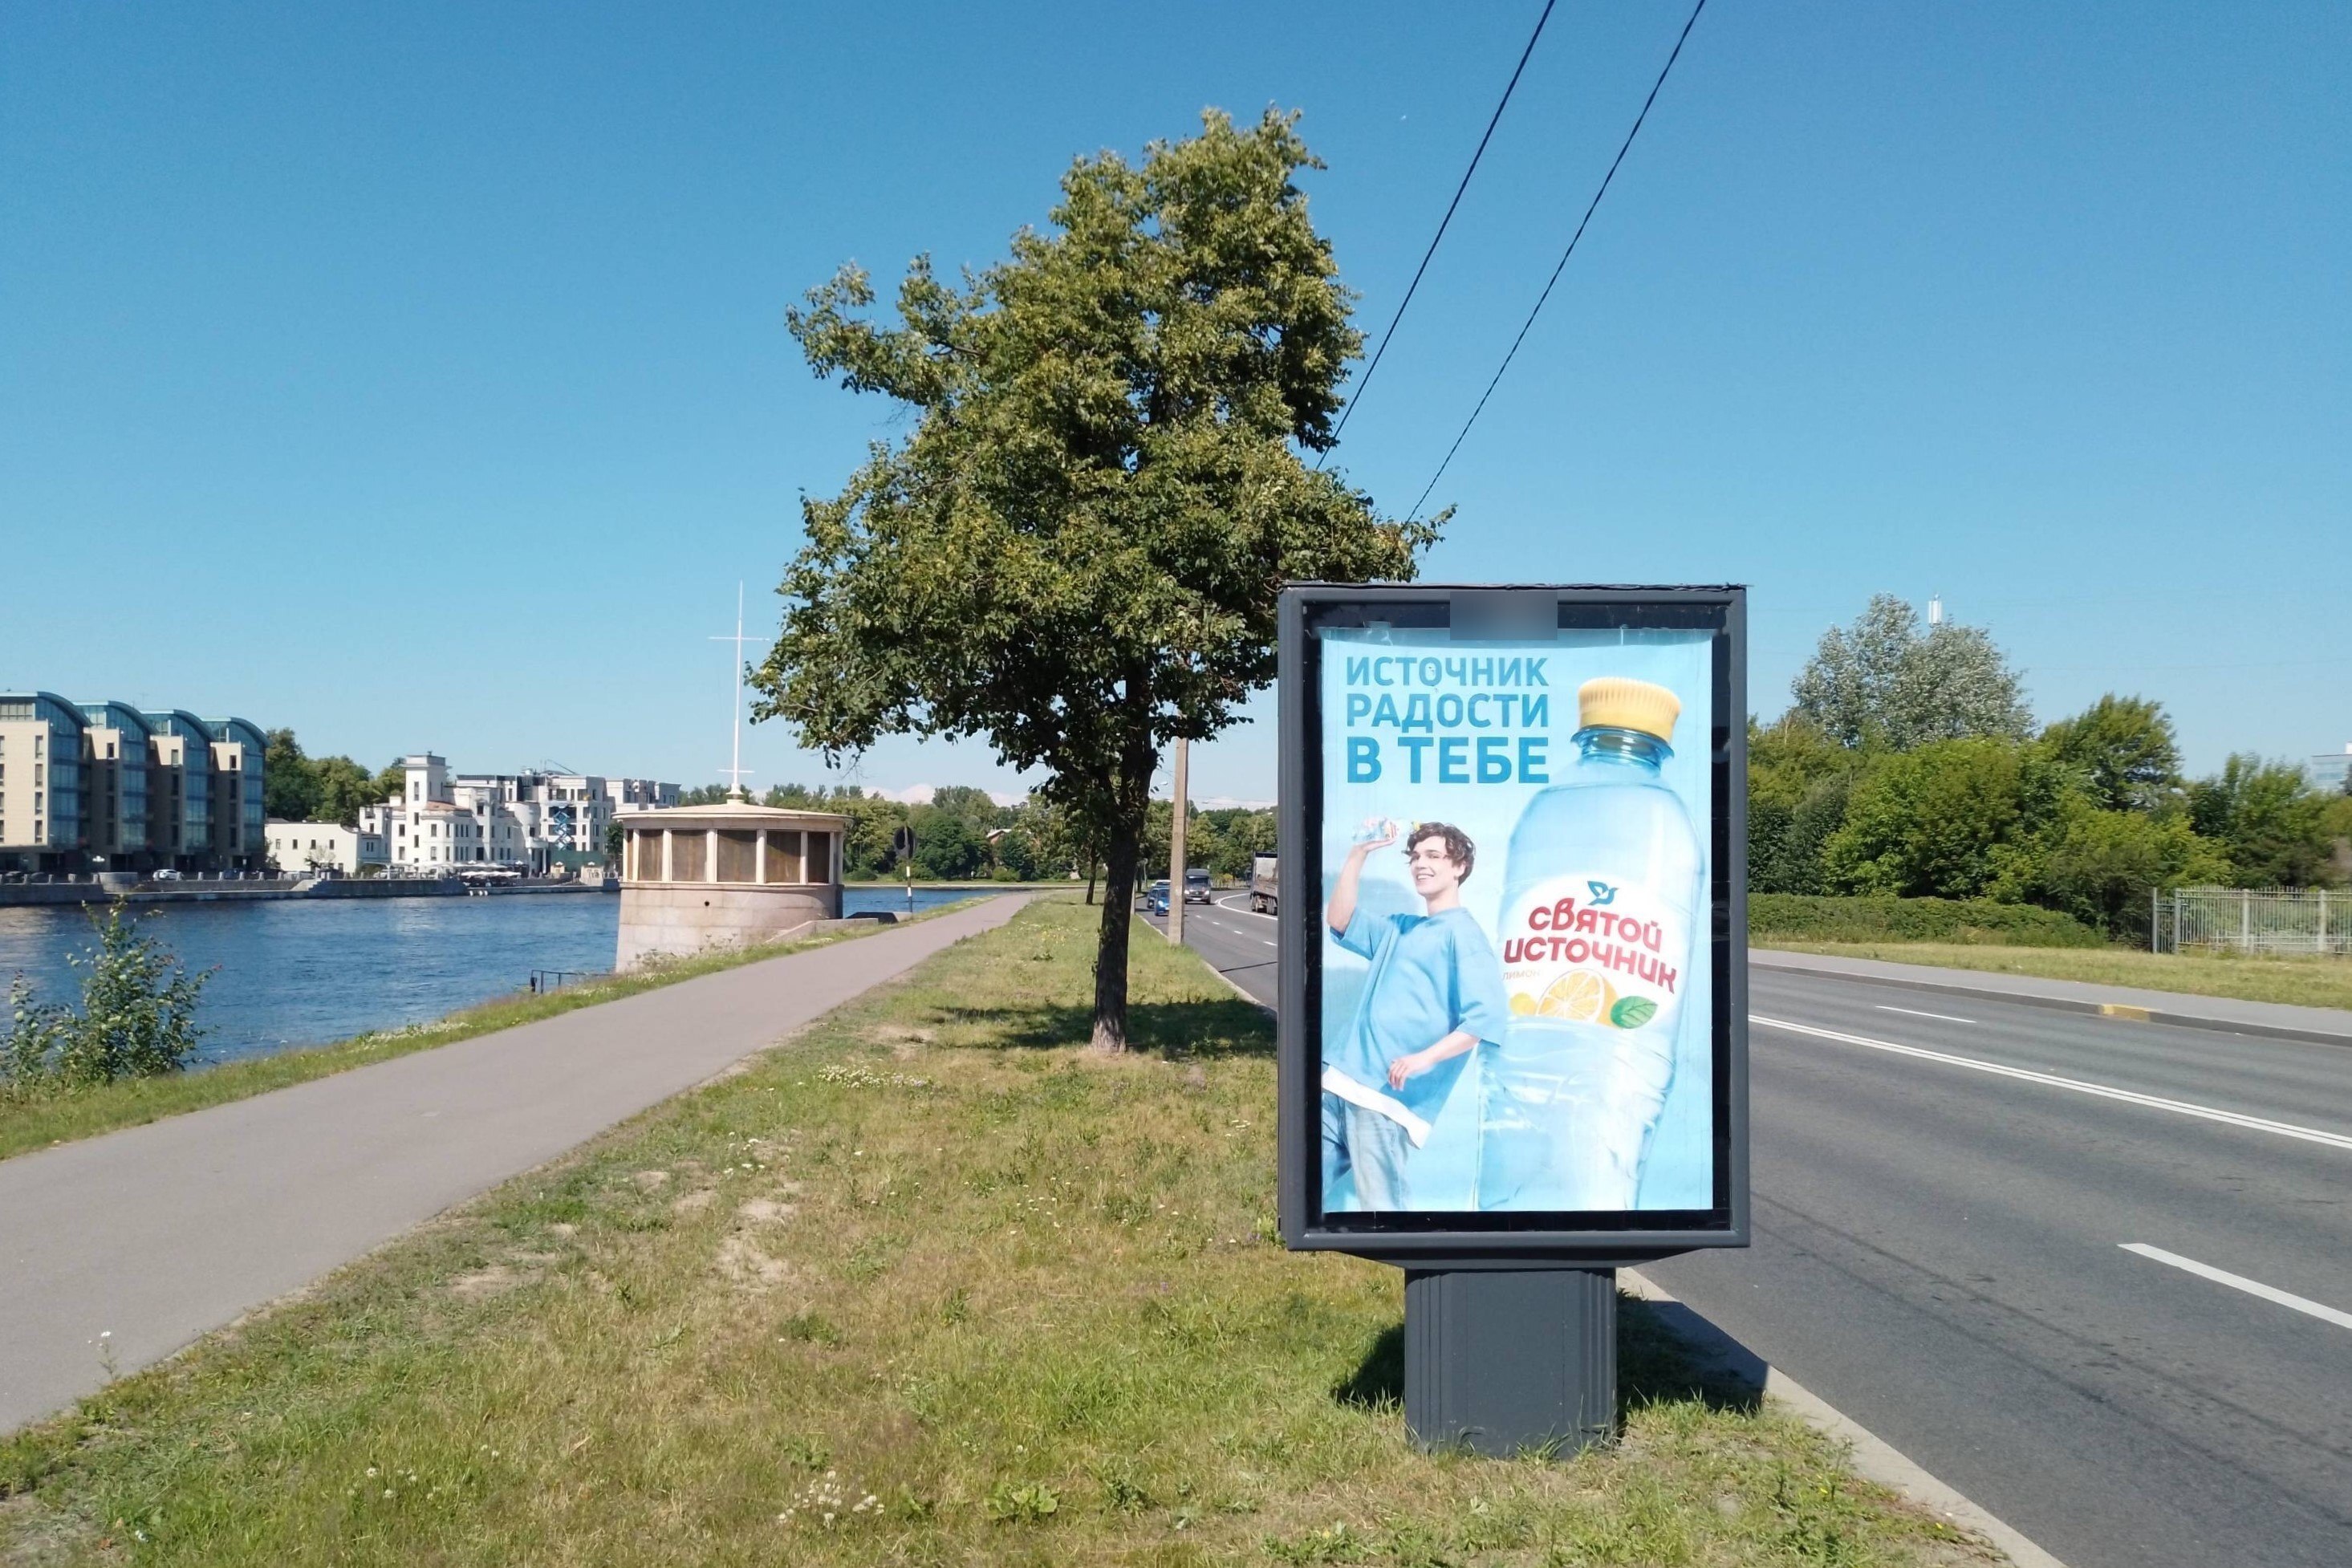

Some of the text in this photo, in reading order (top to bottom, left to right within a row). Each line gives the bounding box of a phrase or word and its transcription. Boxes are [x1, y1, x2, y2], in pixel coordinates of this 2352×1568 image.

[1347, 656, 1550, 687] ИСТОЧНИК
[1347, 693, 1549, 733] РАДОСТИ
[1347, 737, 1550, 784] В ТЕБЕ
